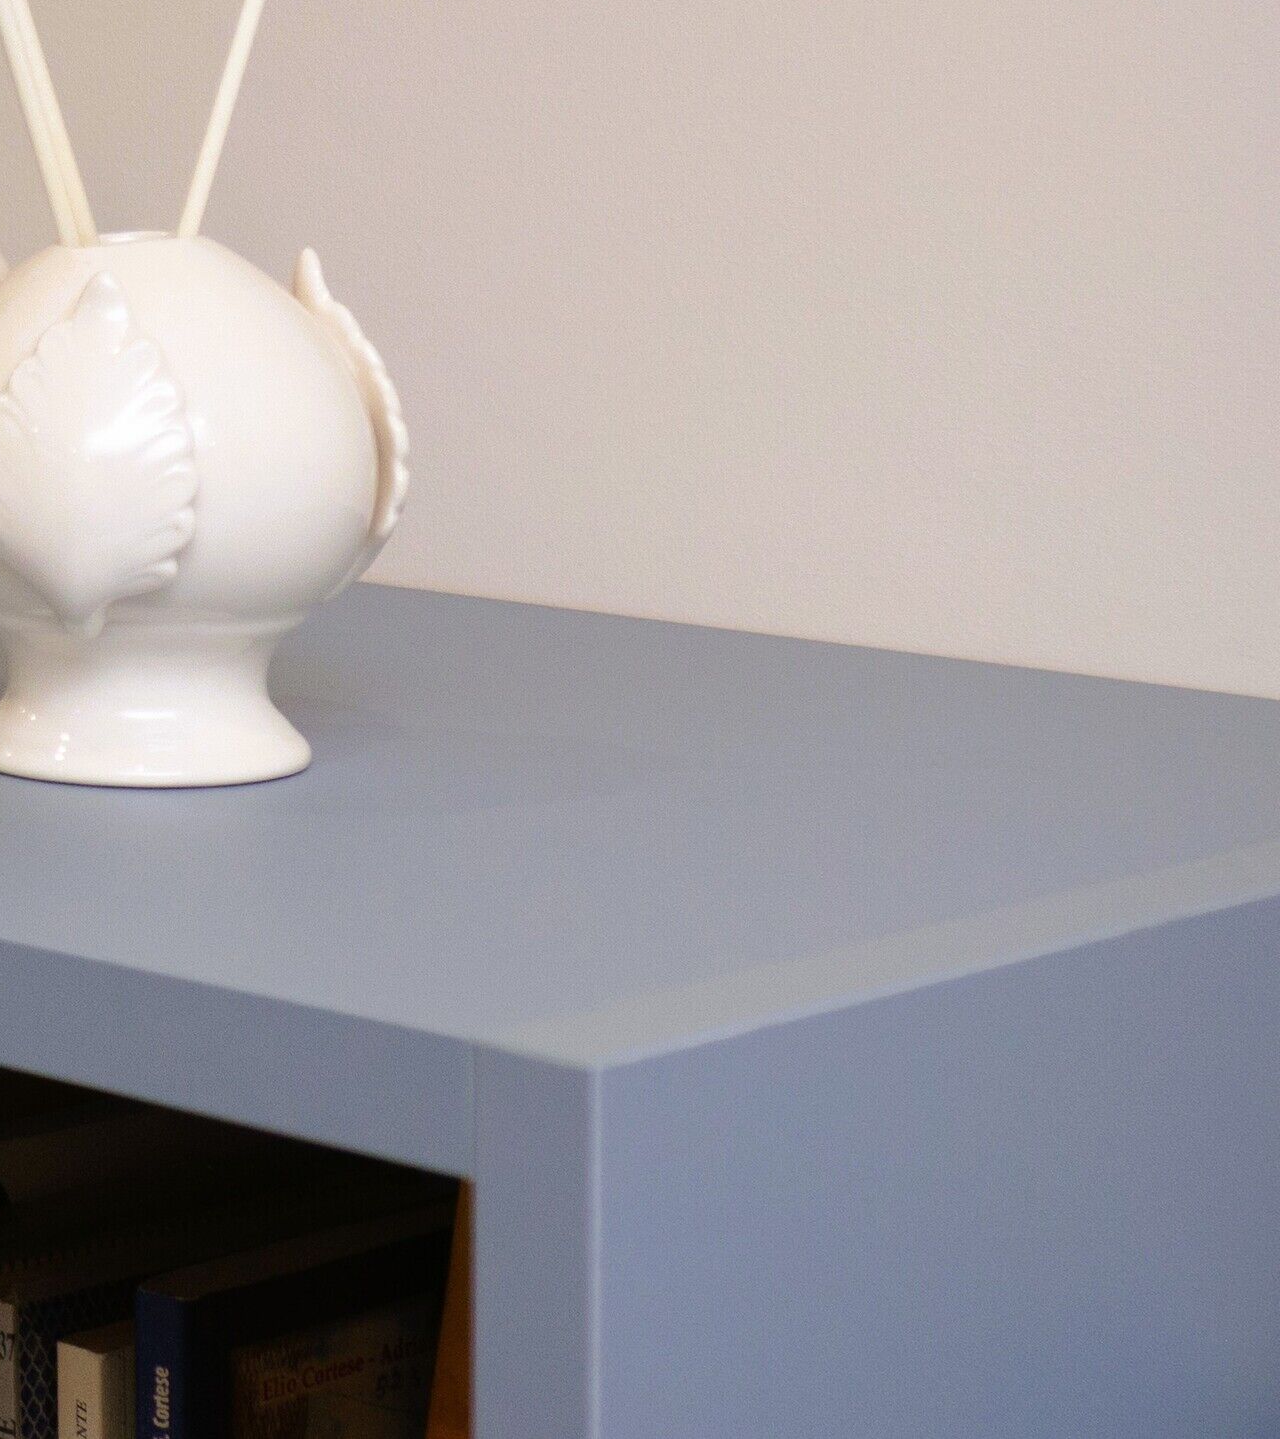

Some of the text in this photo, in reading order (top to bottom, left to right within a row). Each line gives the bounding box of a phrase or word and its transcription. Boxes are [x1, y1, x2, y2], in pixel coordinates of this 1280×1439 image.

[151, 1365, 170, 1429] Cortese
[262, 1374, 298, 1402] Elio
[301, 1355, 366, 1389] Cortese
